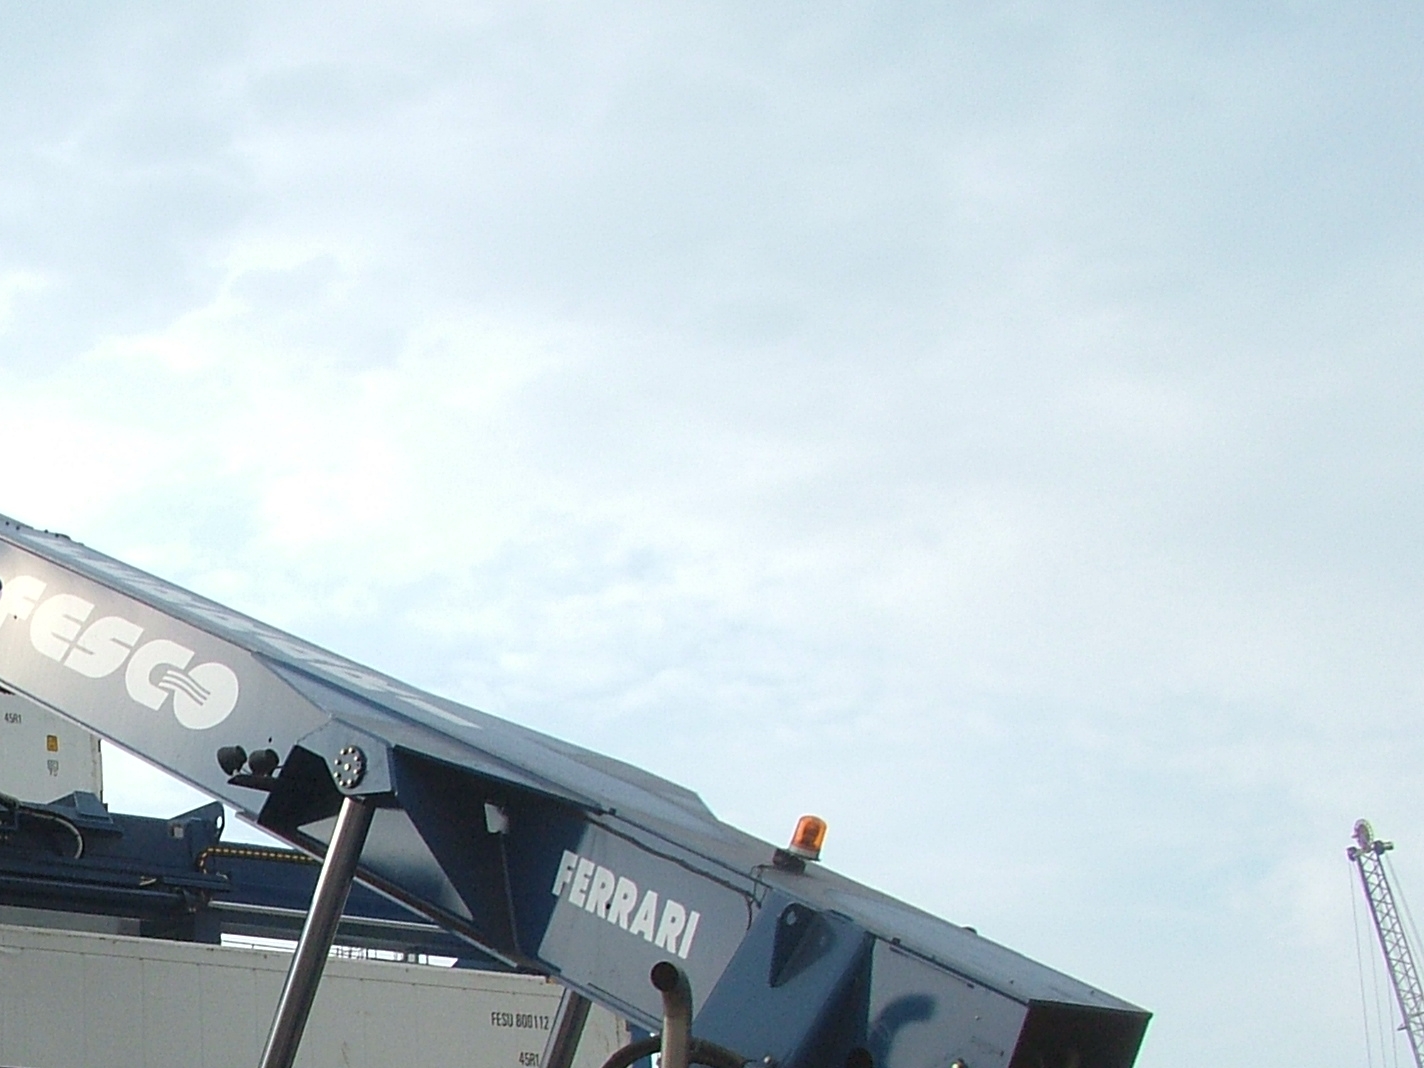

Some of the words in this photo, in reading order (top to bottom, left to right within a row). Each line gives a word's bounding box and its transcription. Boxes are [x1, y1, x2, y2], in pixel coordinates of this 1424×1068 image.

[551, 850, 701, 960] FERRARI
[491, 1012, 514, 1028] FESU
[516, 1013, 549, 1030] 800112
